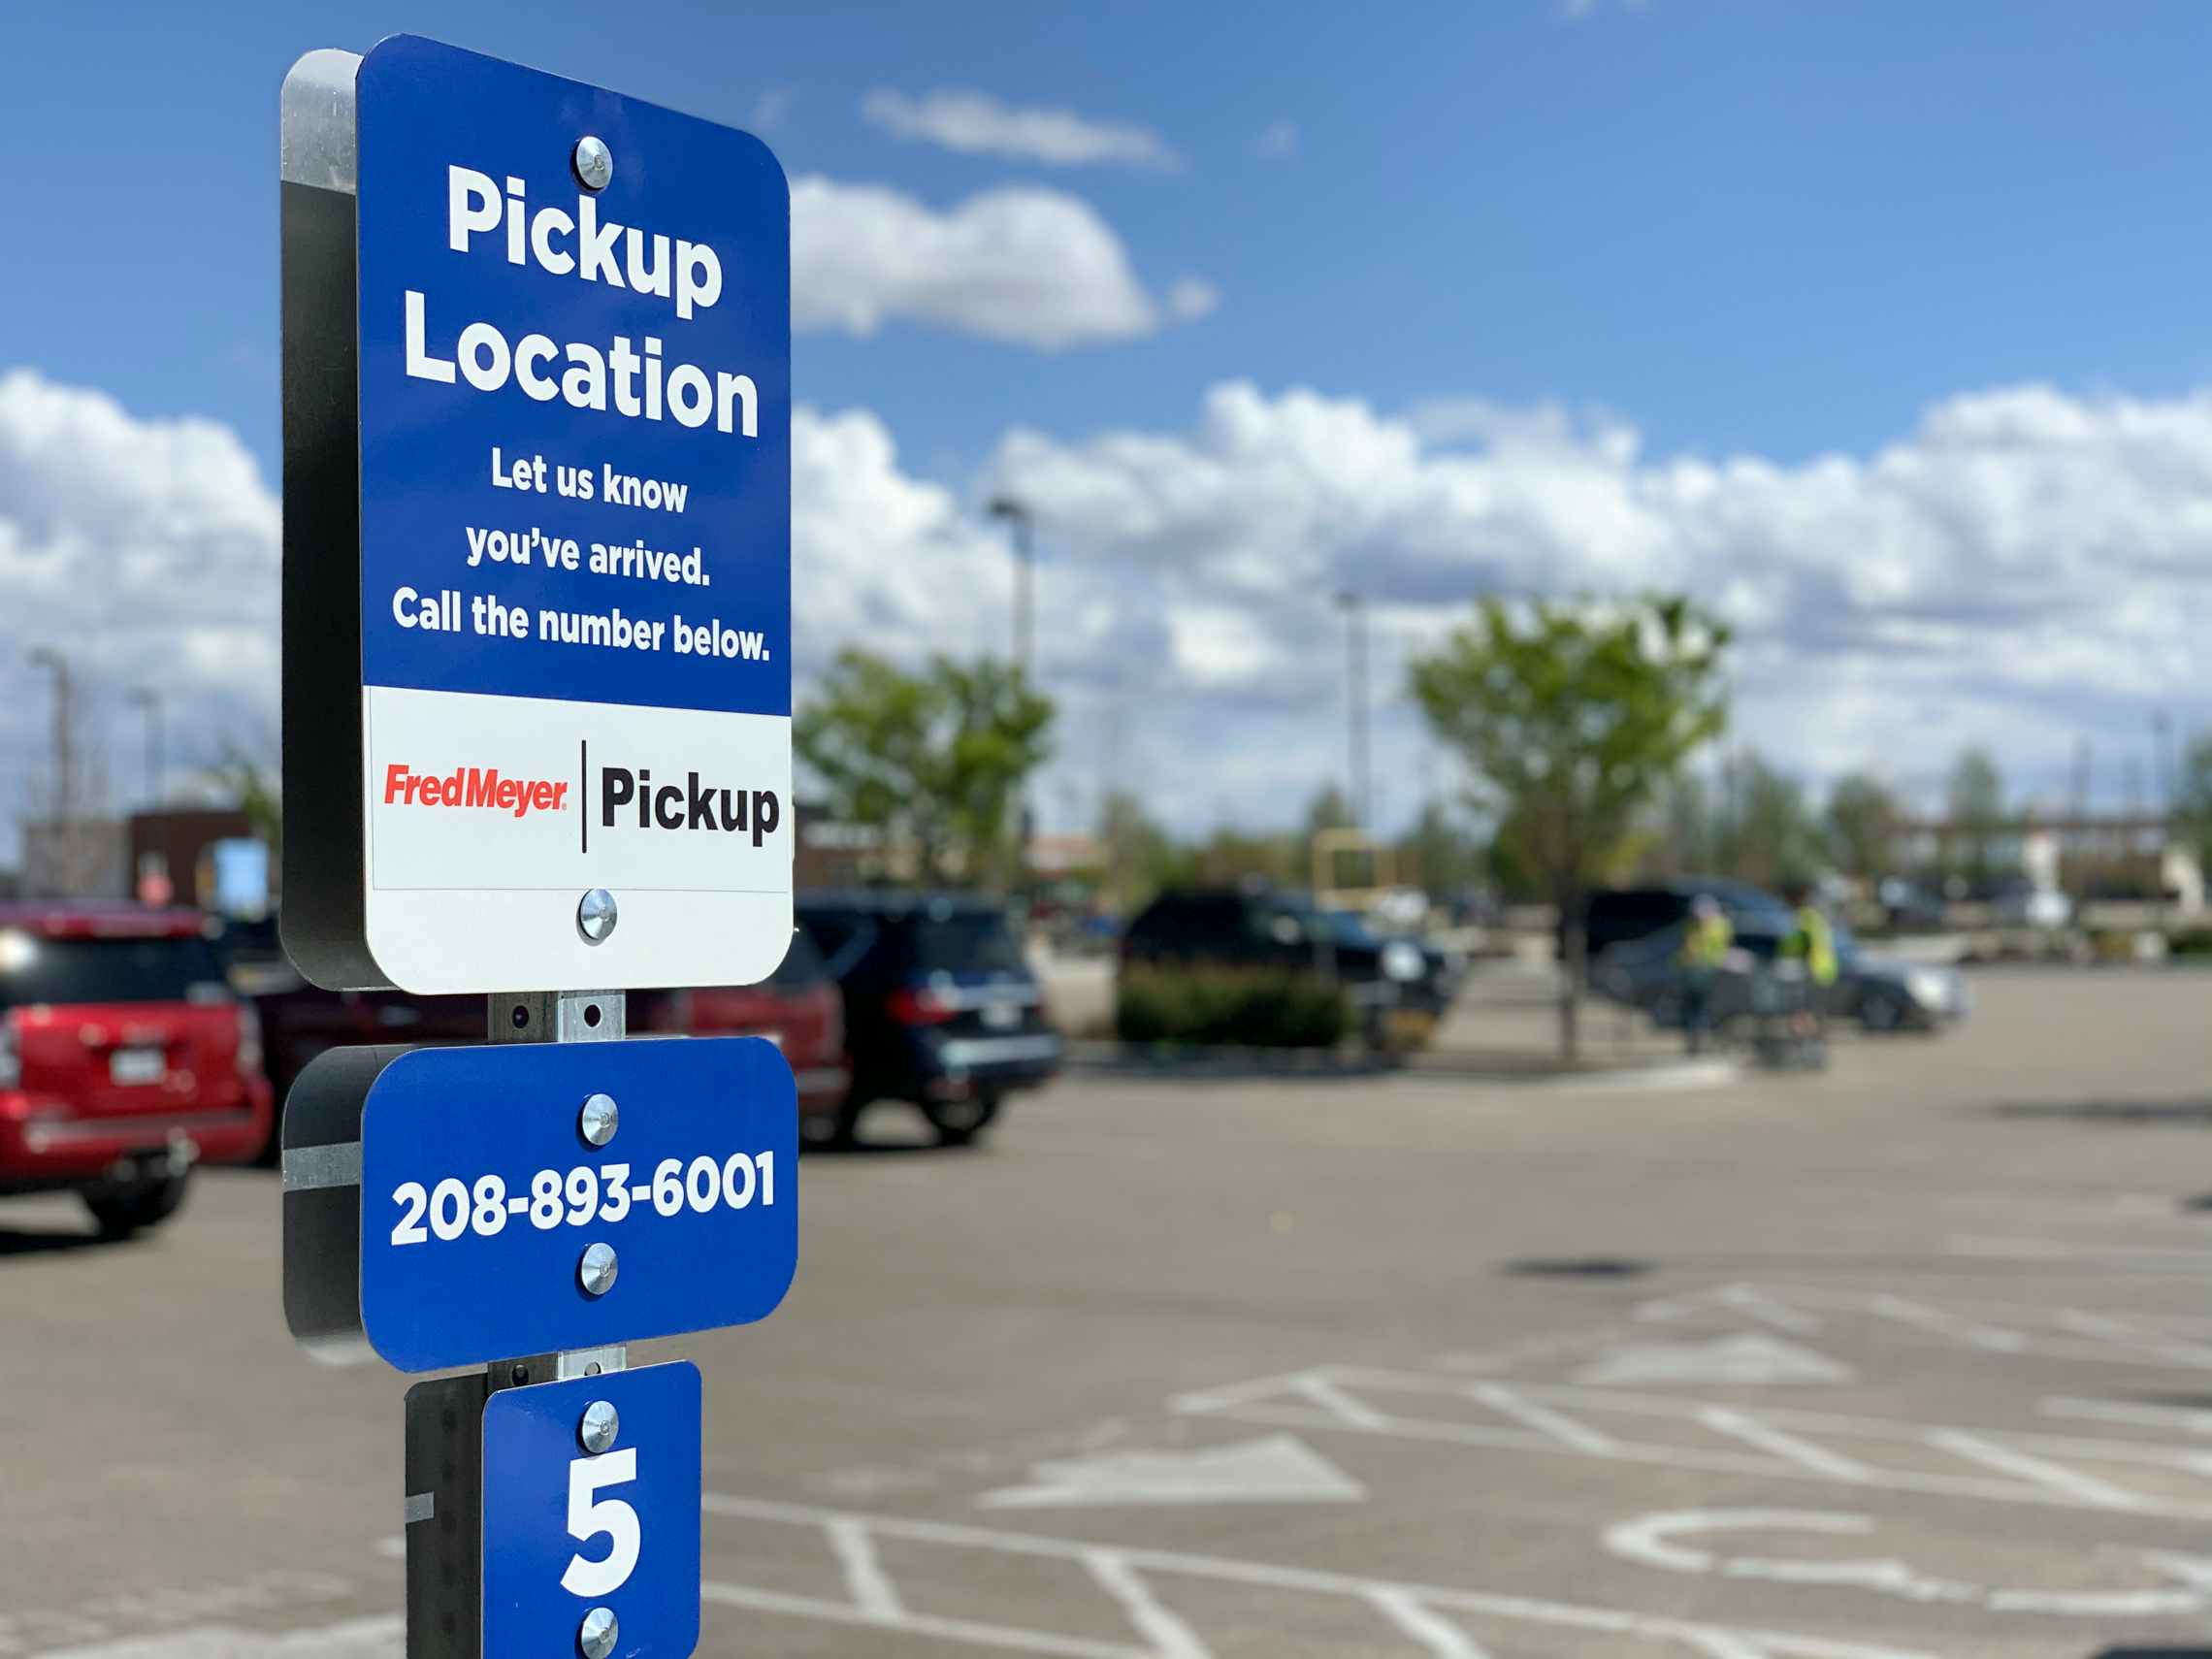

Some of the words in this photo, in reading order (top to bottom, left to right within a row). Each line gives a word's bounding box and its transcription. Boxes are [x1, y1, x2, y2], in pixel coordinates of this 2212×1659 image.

[448, 165, 723, 320] Pickup
[405, 290, 758, 438] Location
[492, 446, 547, 494] Let
[557, 465, 595, 500] us
[603, 463, 688, 513] know
[589, 539, 710, 586] arrived.
[392, 586, 463, 636] Call
[472, 594, 530, 638] the
[539, 608, 666, 658] number
[673, 614, 770, 662] below.
[602, 766, 780, 848] Pickup
[391, 1151, 774, 1246] 208-893-6001
[560, 1447, 641, 1598] 5
